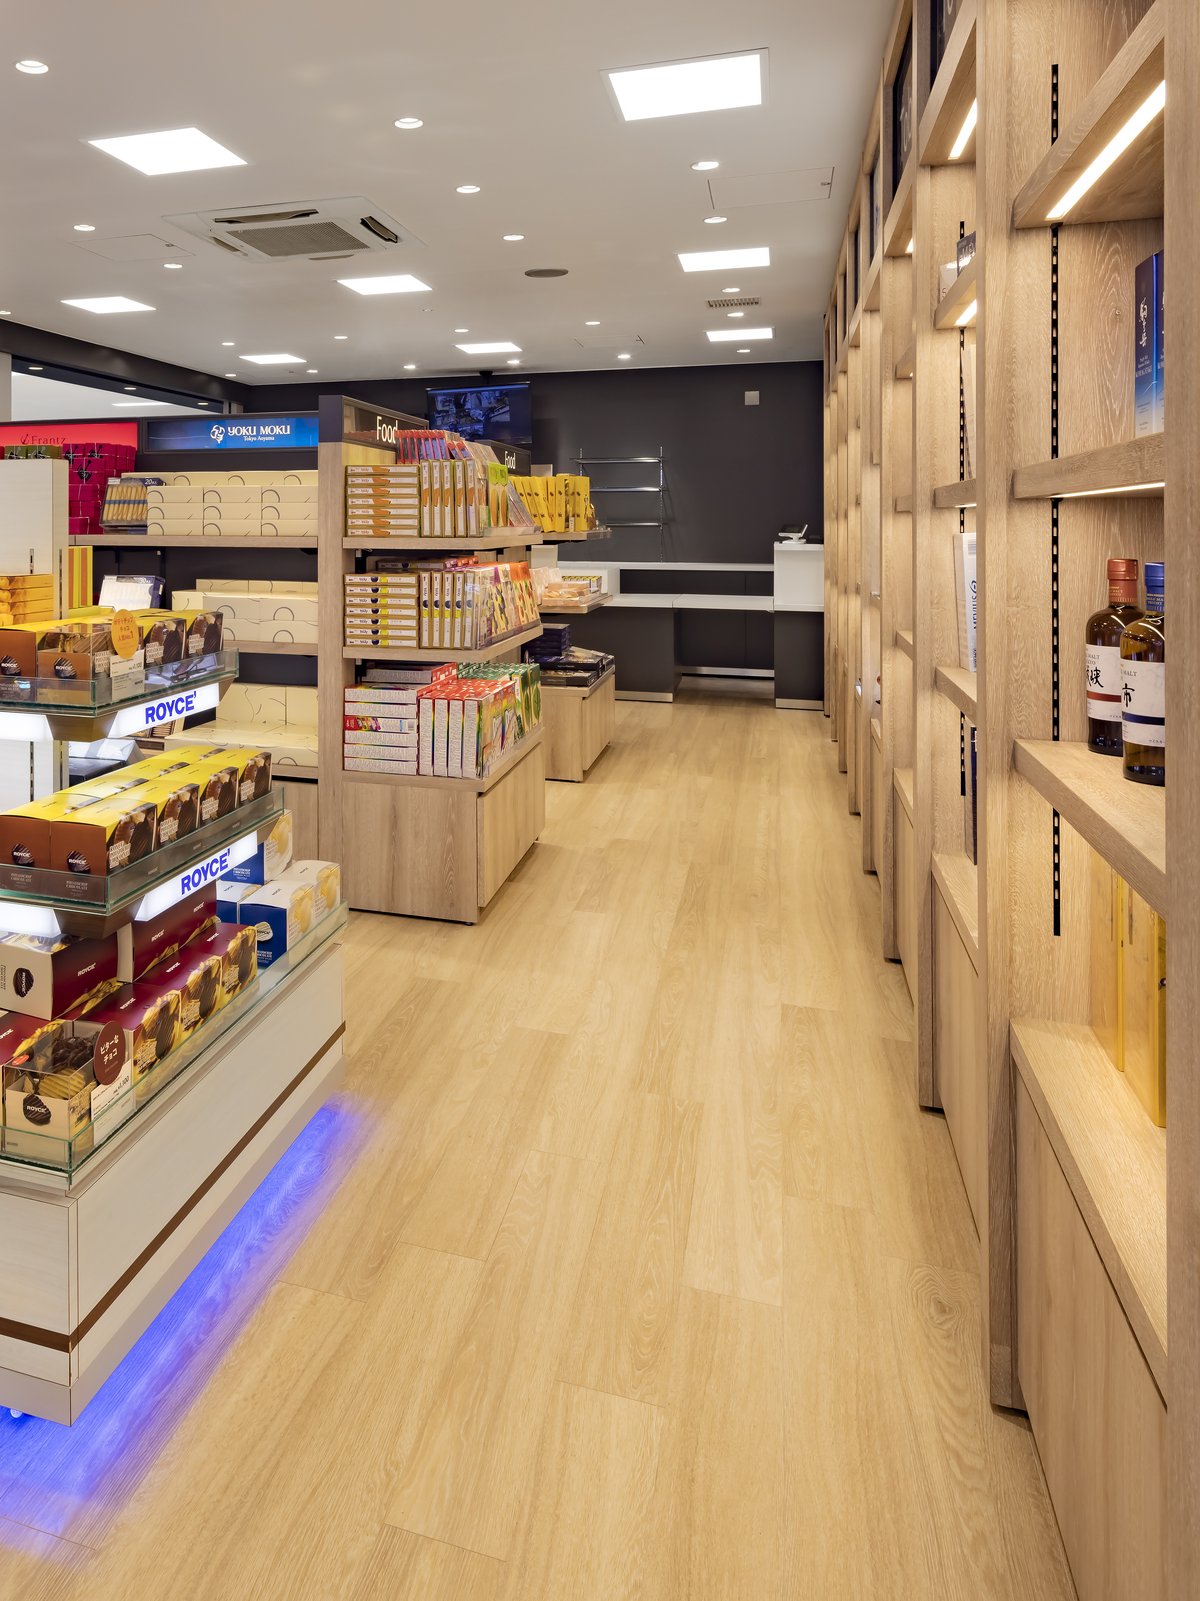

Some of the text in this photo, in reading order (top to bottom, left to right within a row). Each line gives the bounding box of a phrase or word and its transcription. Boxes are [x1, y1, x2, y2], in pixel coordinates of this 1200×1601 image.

[227, 425, 291, 436] YOKU MOKU
[376, 416, 398, 444] Food
[31, 435, 66, 445] Frantz
[504, 451, 516, 470] Food
[145, 691, 197, 724] ROYCE'
[182, 848, 231, 895] ROYCE'
[103, 1048, 118, 1065] チョコ
